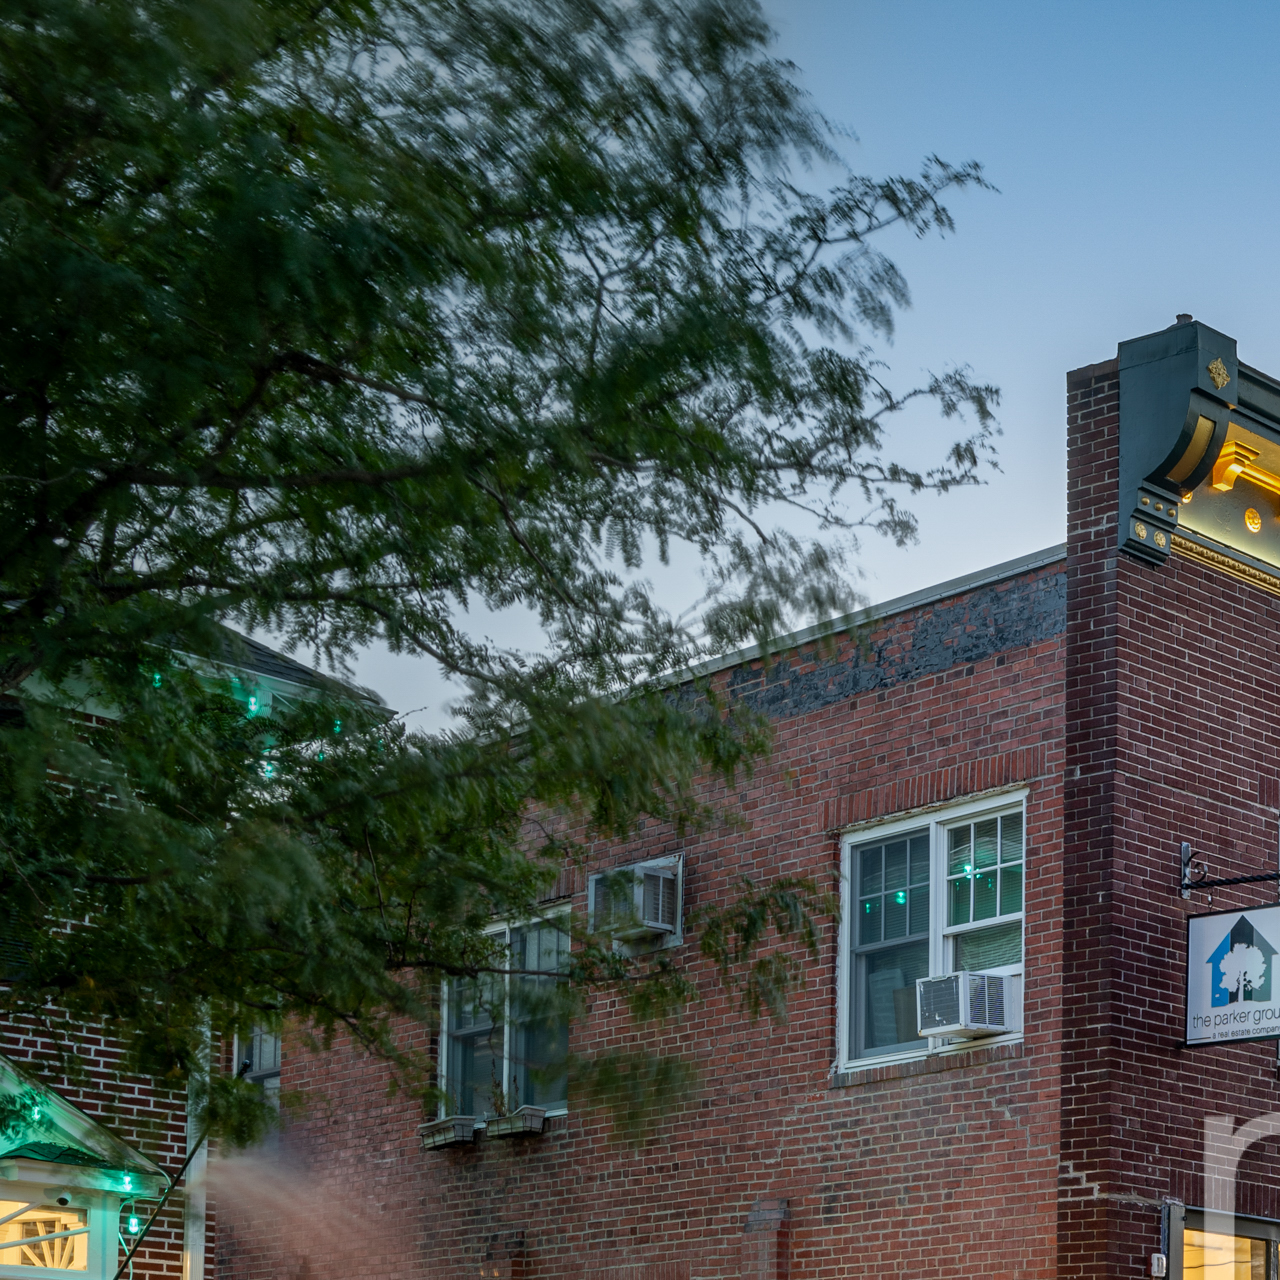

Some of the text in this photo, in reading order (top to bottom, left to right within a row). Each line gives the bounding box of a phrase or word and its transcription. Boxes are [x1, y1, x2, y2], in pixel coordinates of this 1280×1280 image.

[1193, 1013, 1211, 1029] the
[1214, 1009, 1251, 1029] parker
[1218, 1029, 1229, 1038] real
[1231, 1028, 1251, 1037] estate
